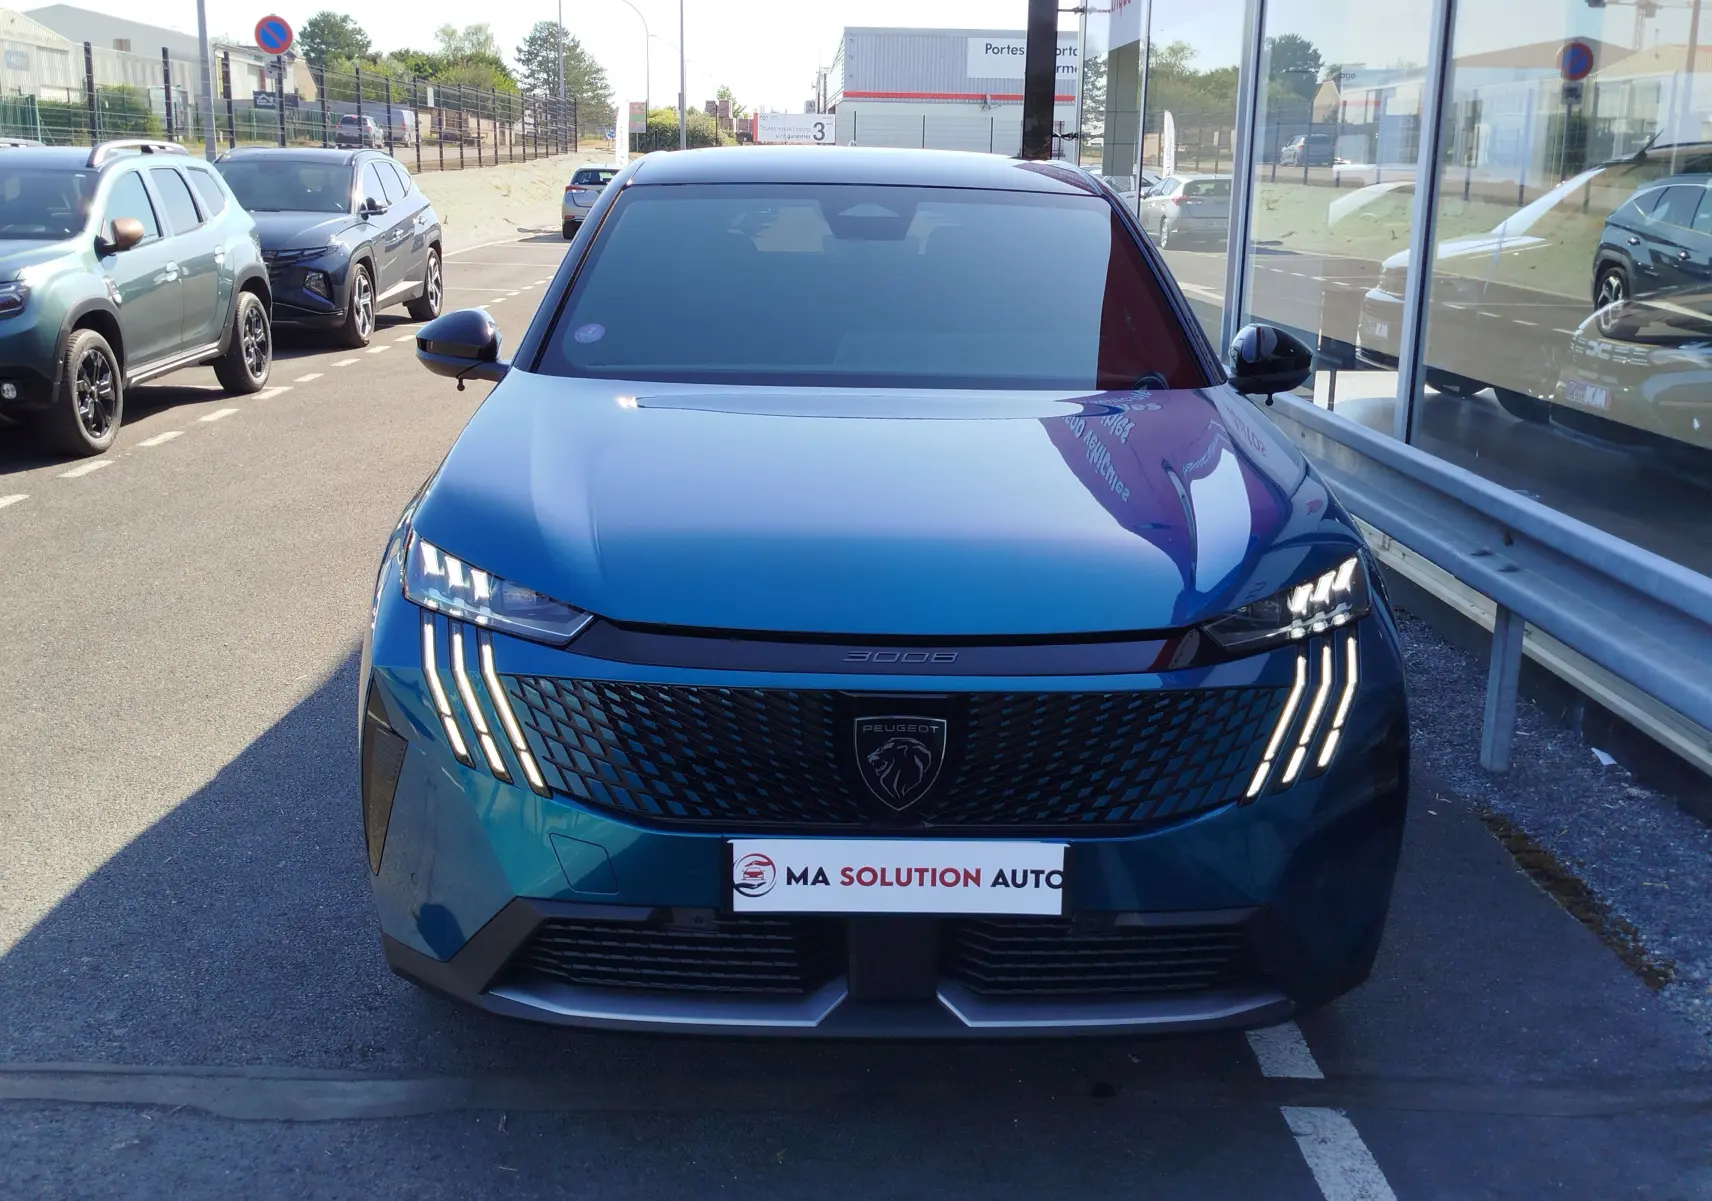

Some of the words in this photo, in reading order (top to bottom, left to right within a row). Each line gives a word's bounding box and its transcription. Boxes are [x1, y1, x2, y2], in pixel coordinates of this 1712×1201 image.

[985, 42, 1025, 56] Portes
[812, 121, 826, 142] 3
[842, 650, 959, 664] 3008
[862, 724, 939, 735] PEUGEOT
[786, 866, 831, 886] MA
[840, 866, 981, 888] SOLUTION
[990, 868, 1064, 890] AUTO
